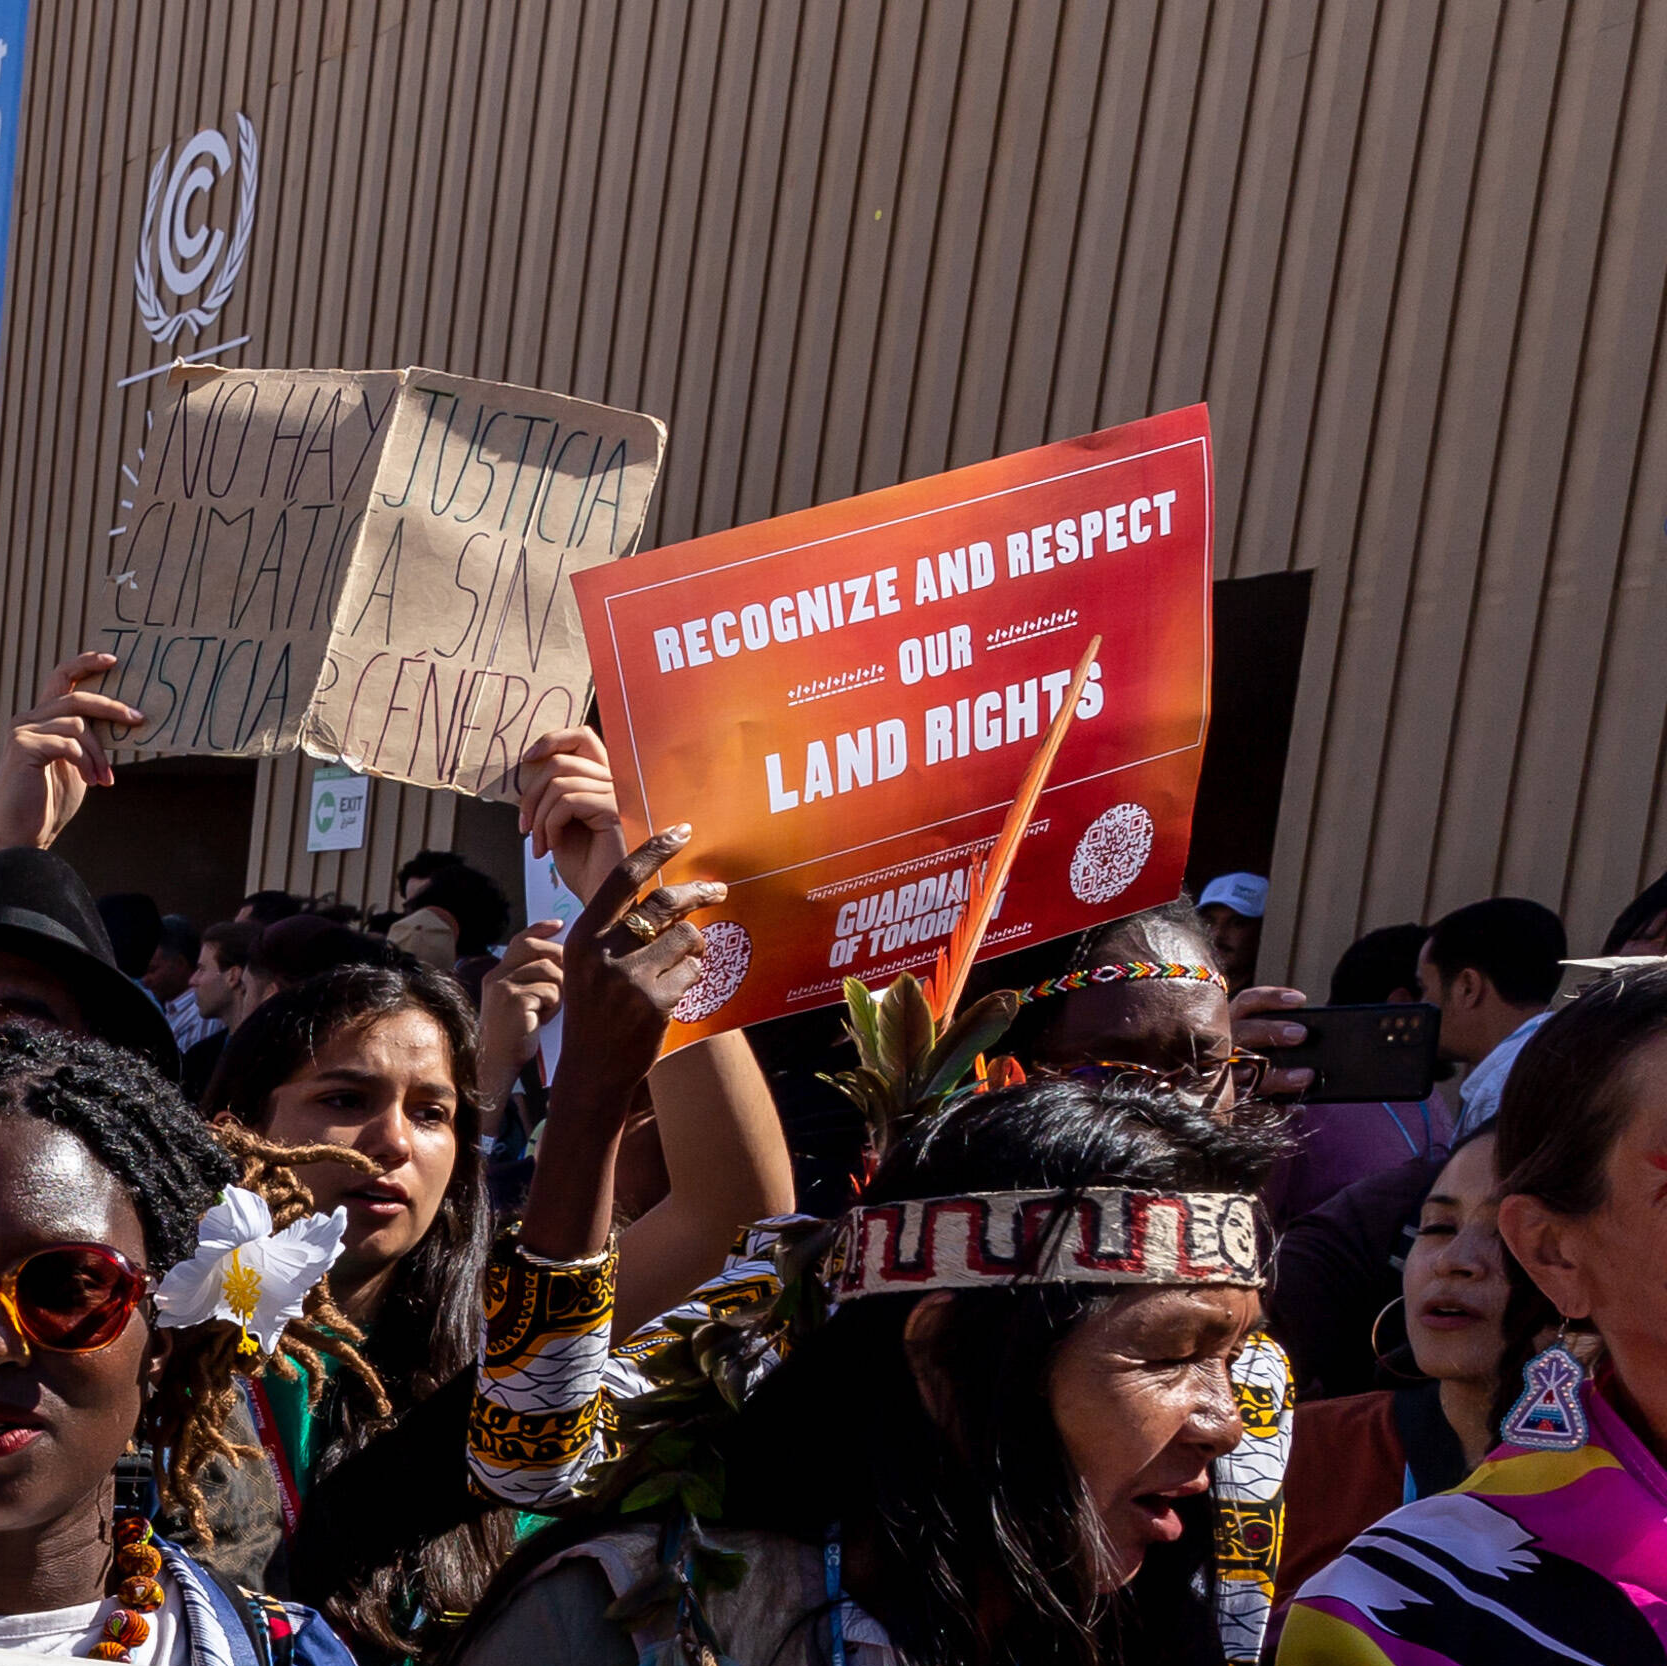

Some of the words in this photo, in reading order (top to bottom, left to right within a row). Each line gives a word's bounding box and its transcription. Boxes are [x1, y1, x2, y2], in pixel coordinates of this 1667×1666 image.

[154, 379, 259, 499] NO
[261, 383, 396, 501] HAY
[381, 386, 628, 555] JUSTICIA
[116, 498, 404, 646] CLIMÁTICA
[433, 532, 565, 673] SIN
[653, 566, 902, 674] RECOGNIZE
[914, 541, 996, 607] AND
[1006, 489, 1178, 579] RESPECT
[897, 624, 973, 686] OUR
[341, 650, 573, 796] GÉNERO
[764, 717, 908, 815] LAND
[924, 660, 1105, 767] RIGHTS
[339, 795, 364, 813] EXIT
[828, 935, 863, 969] OF
